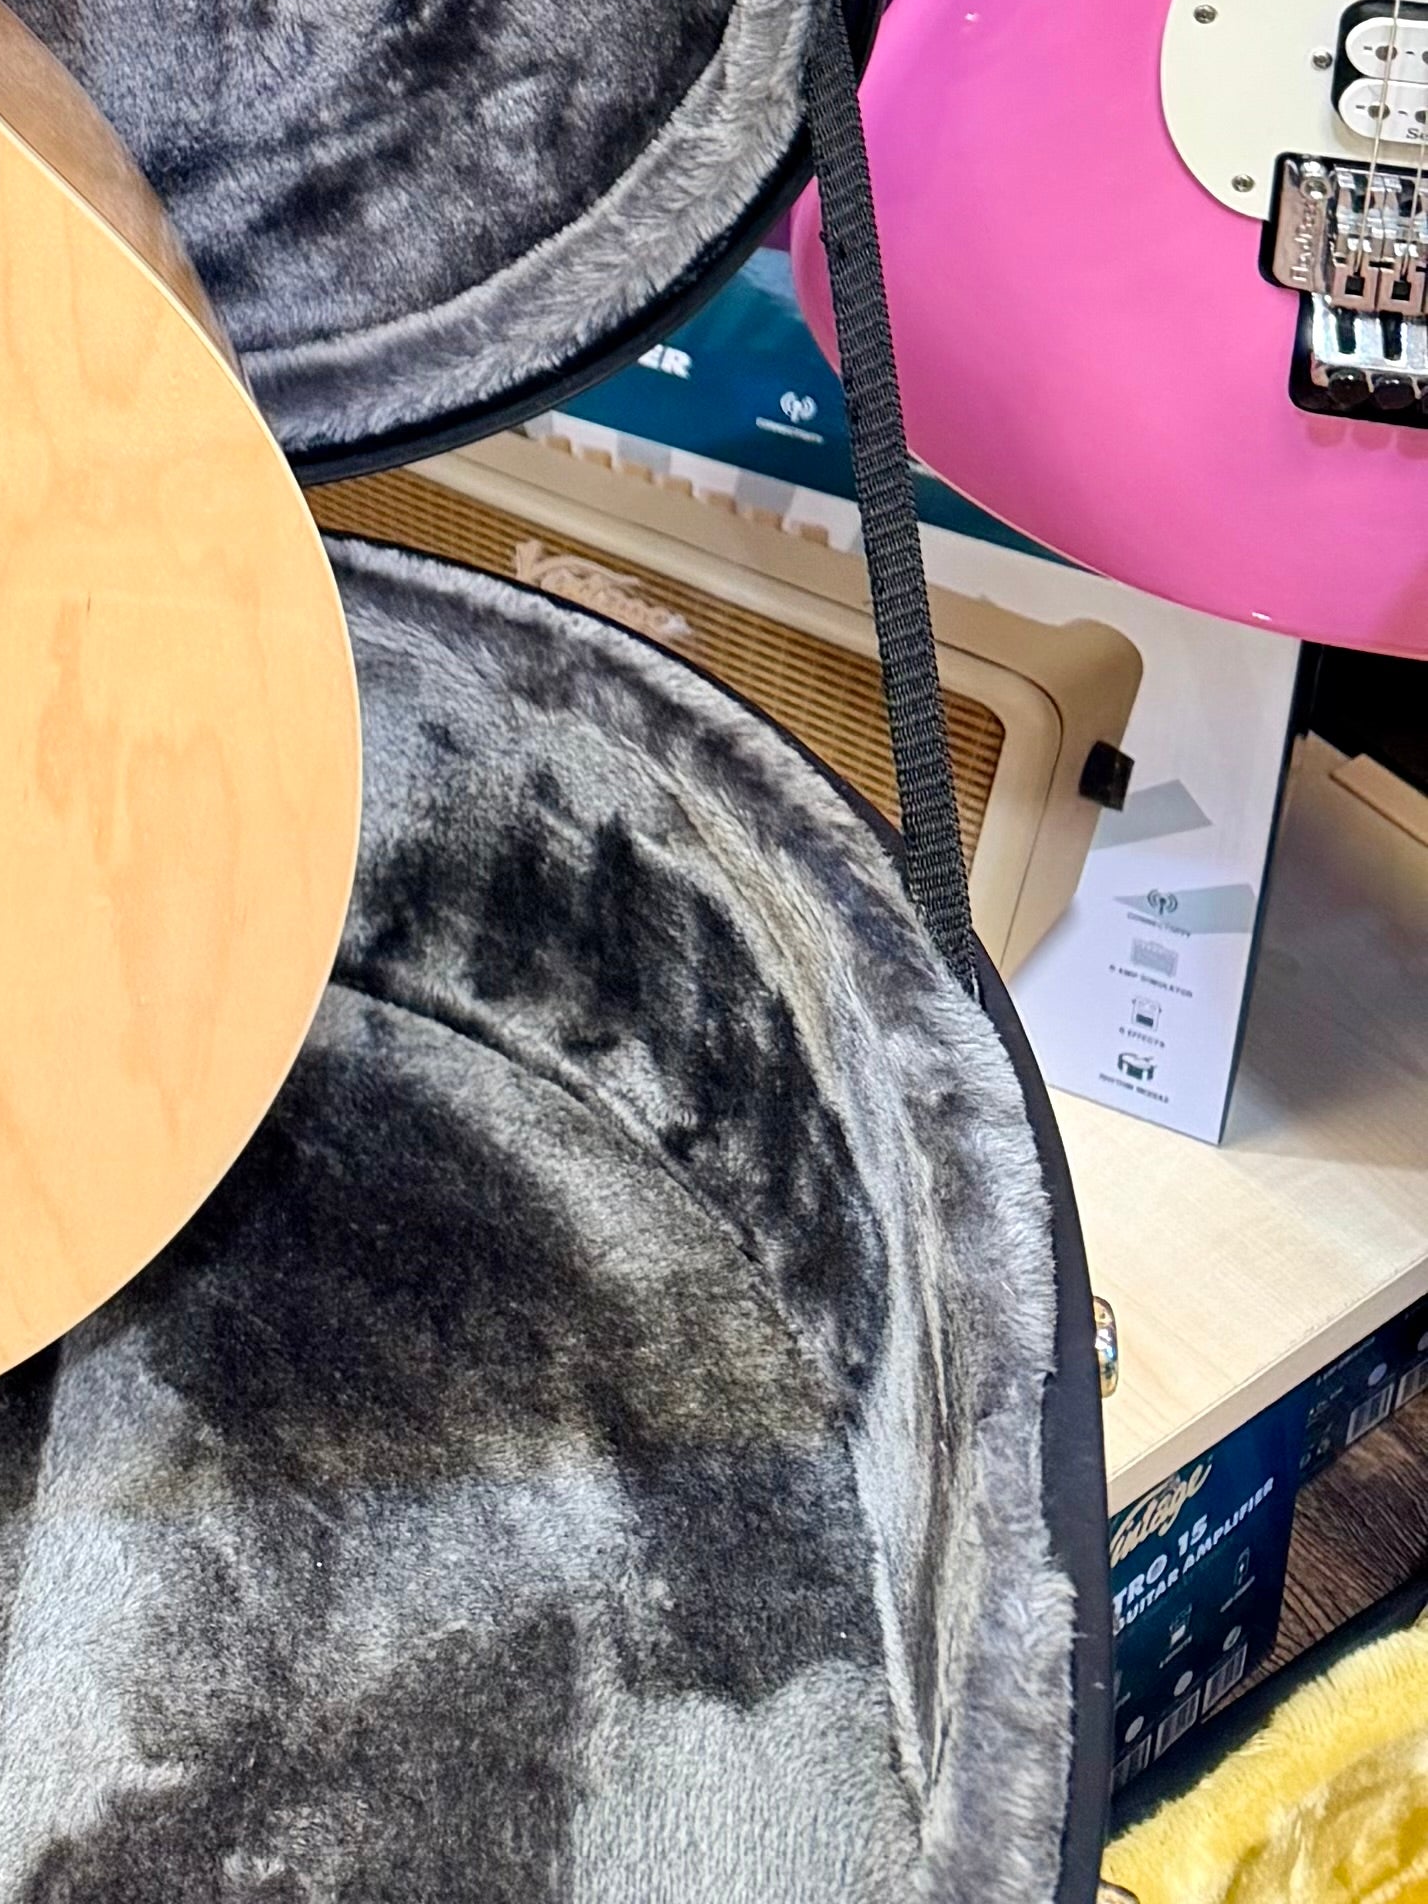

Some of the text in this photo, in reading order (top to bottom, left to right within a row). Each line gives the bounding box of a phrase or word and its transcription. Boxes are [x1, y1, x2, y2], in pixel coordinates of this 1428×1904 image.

[638, 344, 693, 380] ER
[1110, 1463, 1213, 1568] intage
[1112, 1514, 1208, 1614] TRO 15
[1183, 1477, 1274, 1574] AMPLIFIER
